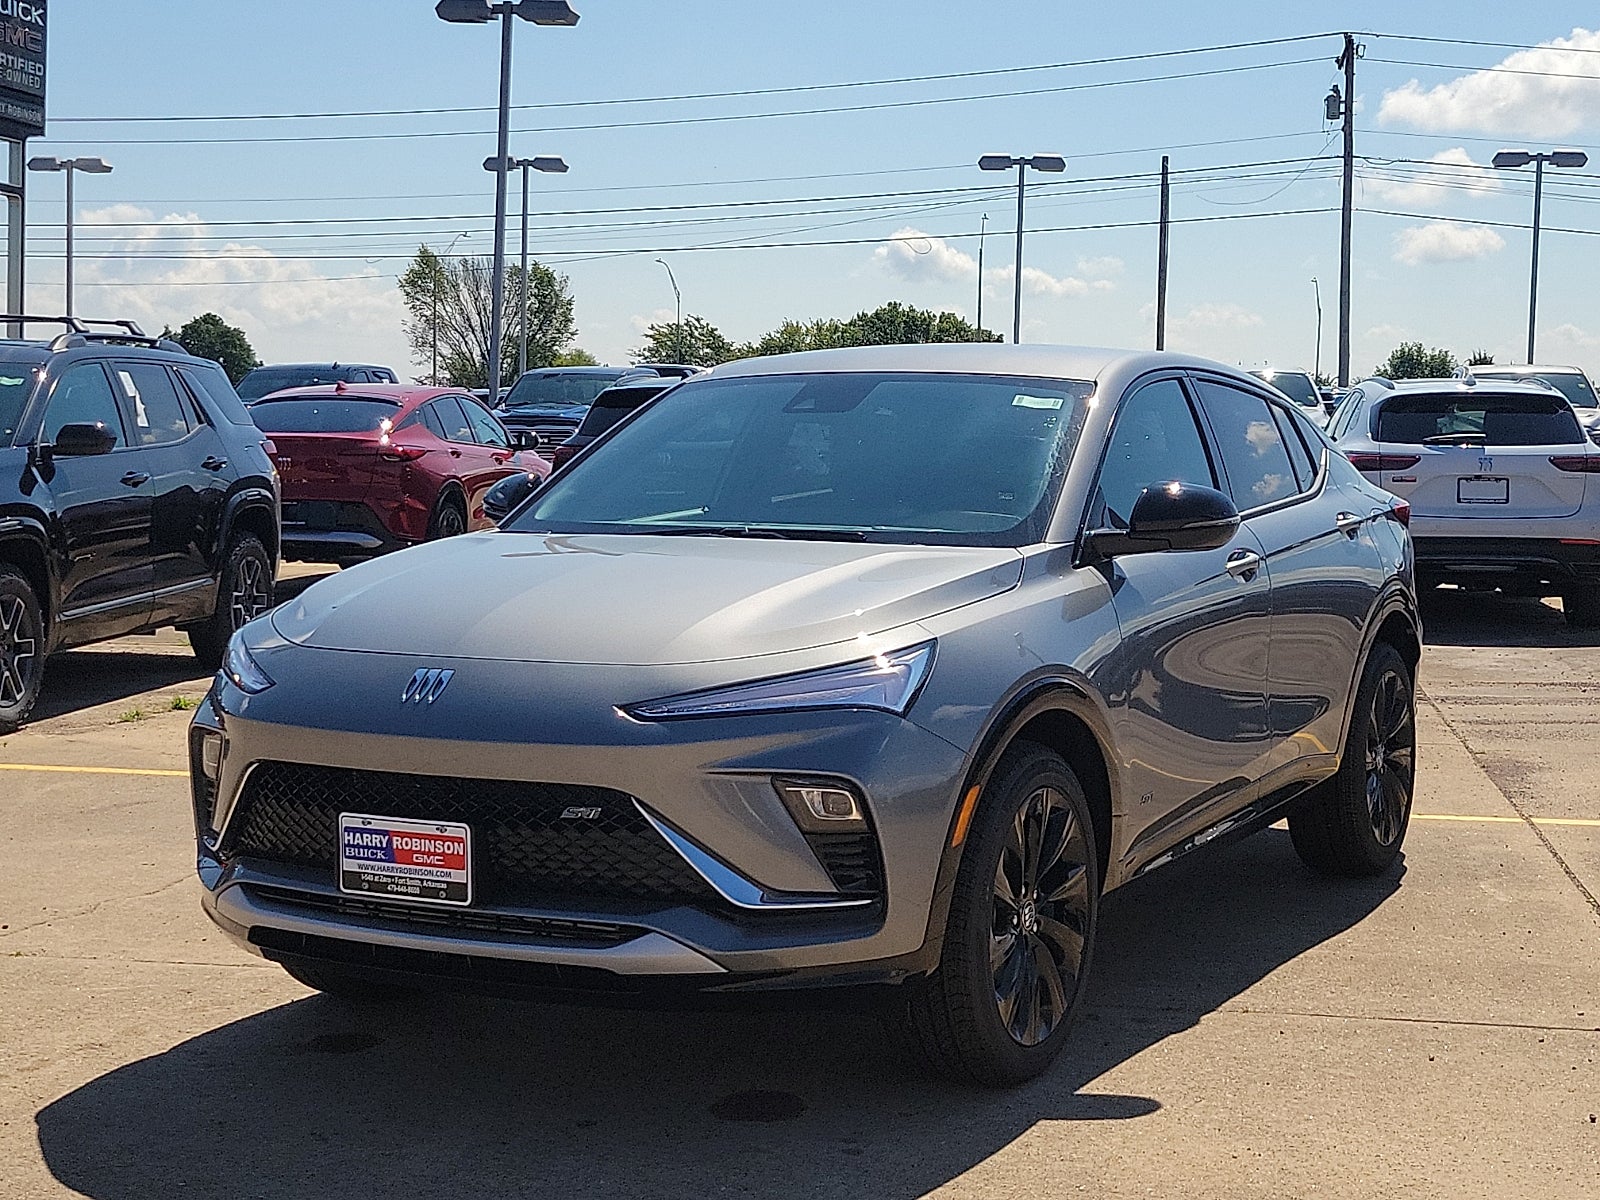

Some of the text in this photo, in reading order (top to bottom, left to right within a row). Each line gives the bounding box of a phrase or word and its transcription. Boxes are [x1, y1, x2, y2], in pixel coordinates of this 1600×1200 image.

[344, 832, 464, 855] HARRY ROBINSON
[345, 847, 444, 864] BUICK GMC
[357, 863, 452, 879] WWW.HARRYROBINSON.COM
